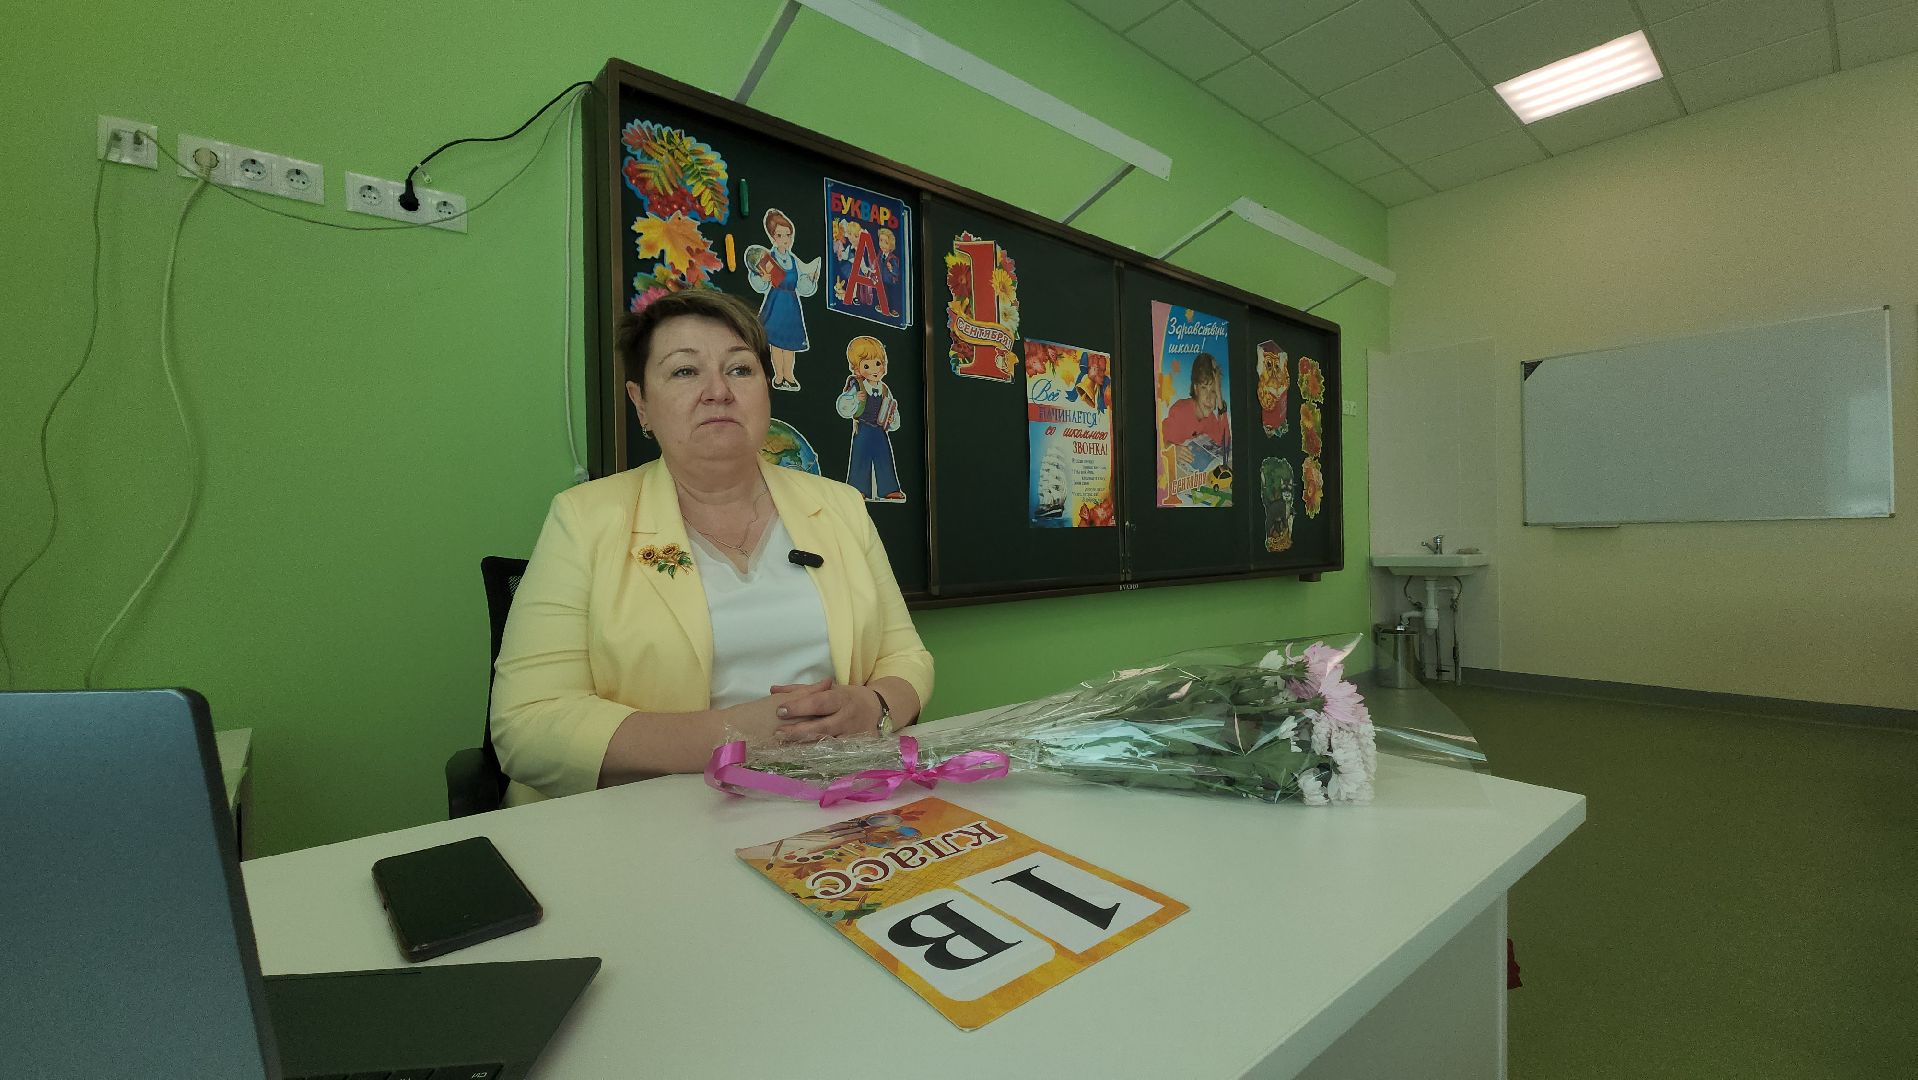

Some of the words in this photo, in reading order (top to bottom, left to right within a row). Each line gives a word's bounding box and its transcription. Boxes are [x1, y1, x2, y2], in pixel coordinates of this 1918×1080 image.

[831, 192, 898, 229] БУКВАРЬ
[843, 231, 890, 316] А
[953, 240, 1012, 382] 1
[1168, 316, 1228, 340] Здравствуй,
[1168, 337, 1206, 354] школа!
[1040, 406, 1098, 428] НАЧИНАЕТСЯ
[1063, 427, 1108, 441] школьного
[1072, 440, 1108, 456] ЗВОНКА!
[1161, 444, 1183, 505] 1
[808, 820, 1004, 897] класс
[887, 899, 1023, 971] В
